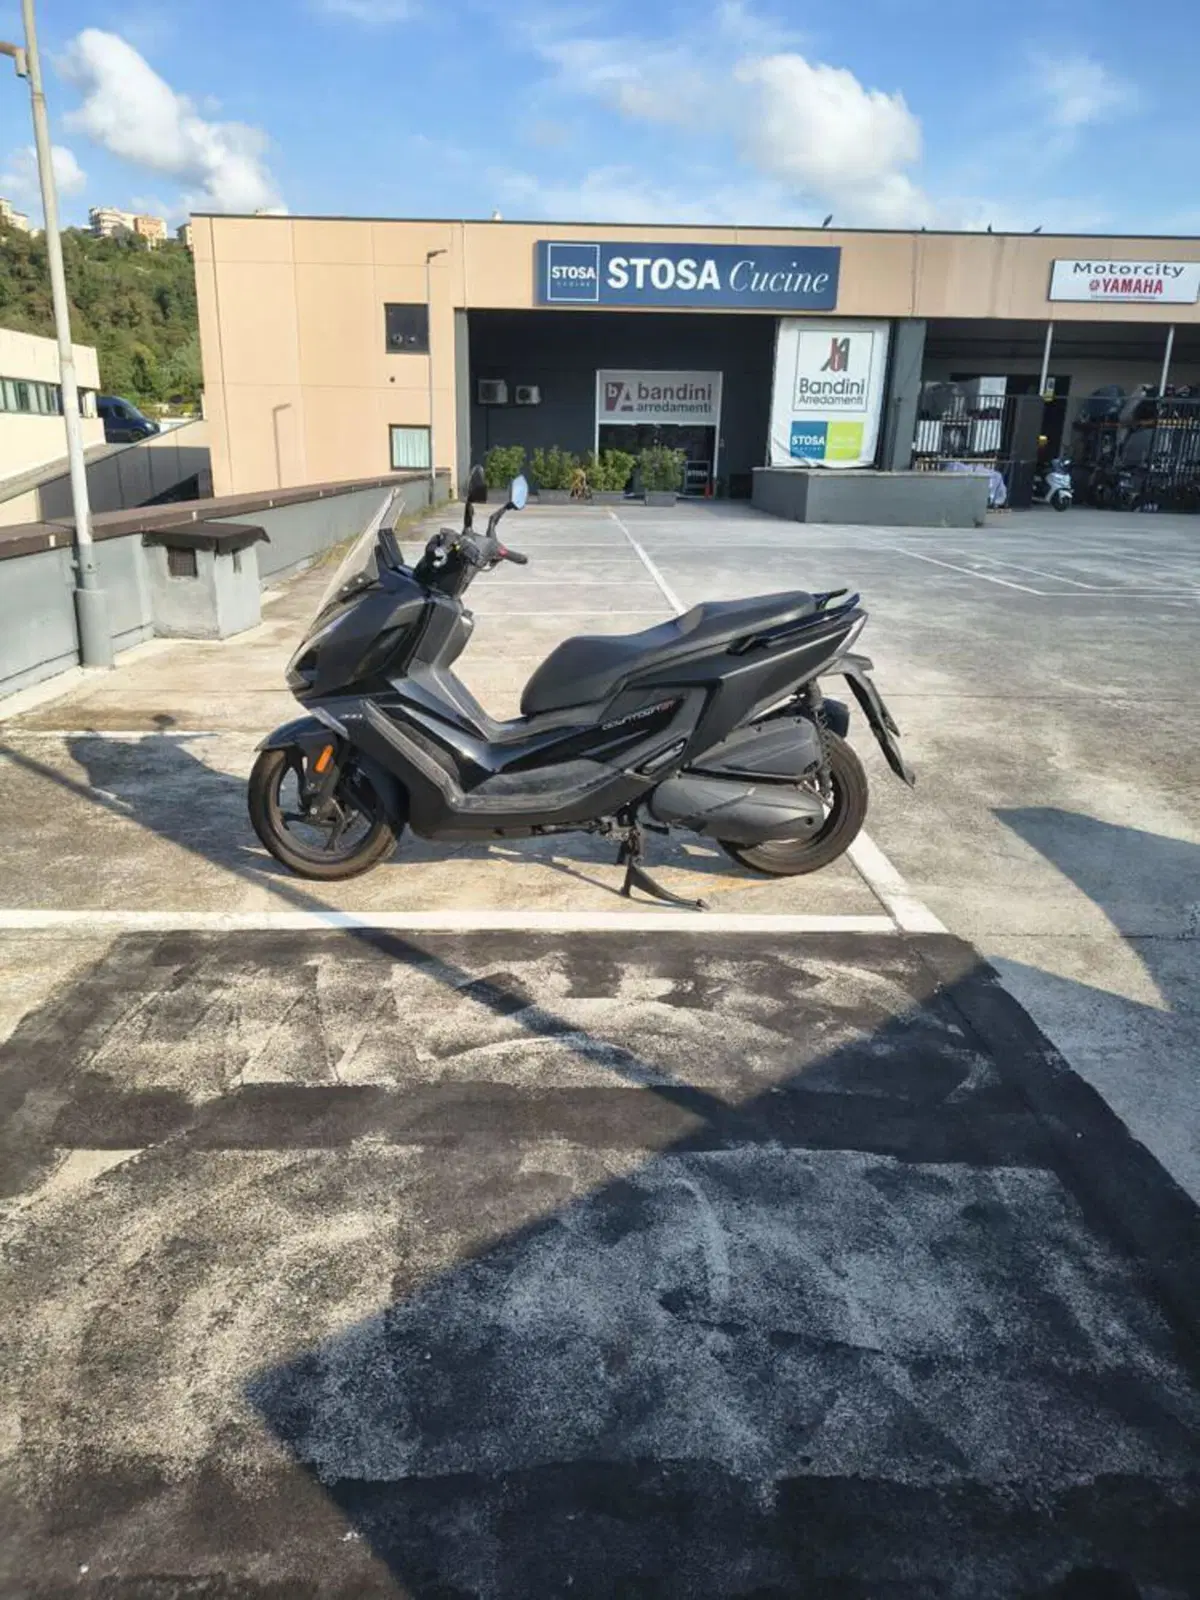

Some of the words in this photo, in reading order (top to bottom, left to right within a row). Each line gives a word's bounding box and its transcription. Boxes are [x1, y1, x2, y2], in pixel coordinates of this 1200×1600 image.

[552, 265, 596, 279] STOSA
[607, 257, 720, 289] STOSA
[729, 260, 829, 293] Cucine
[1072, 262, 1185, 278] Motorcity
[1102, 278, 1163, 294] YAMAHA
[637, 382, 712, 400] bandini
[799, 377, 865, 395] Bandini
[636, 401, 712, 413] arredamenti
[798, 394, 863, 405] Arredamenti
[791, 435, 825, 446] STOSA
